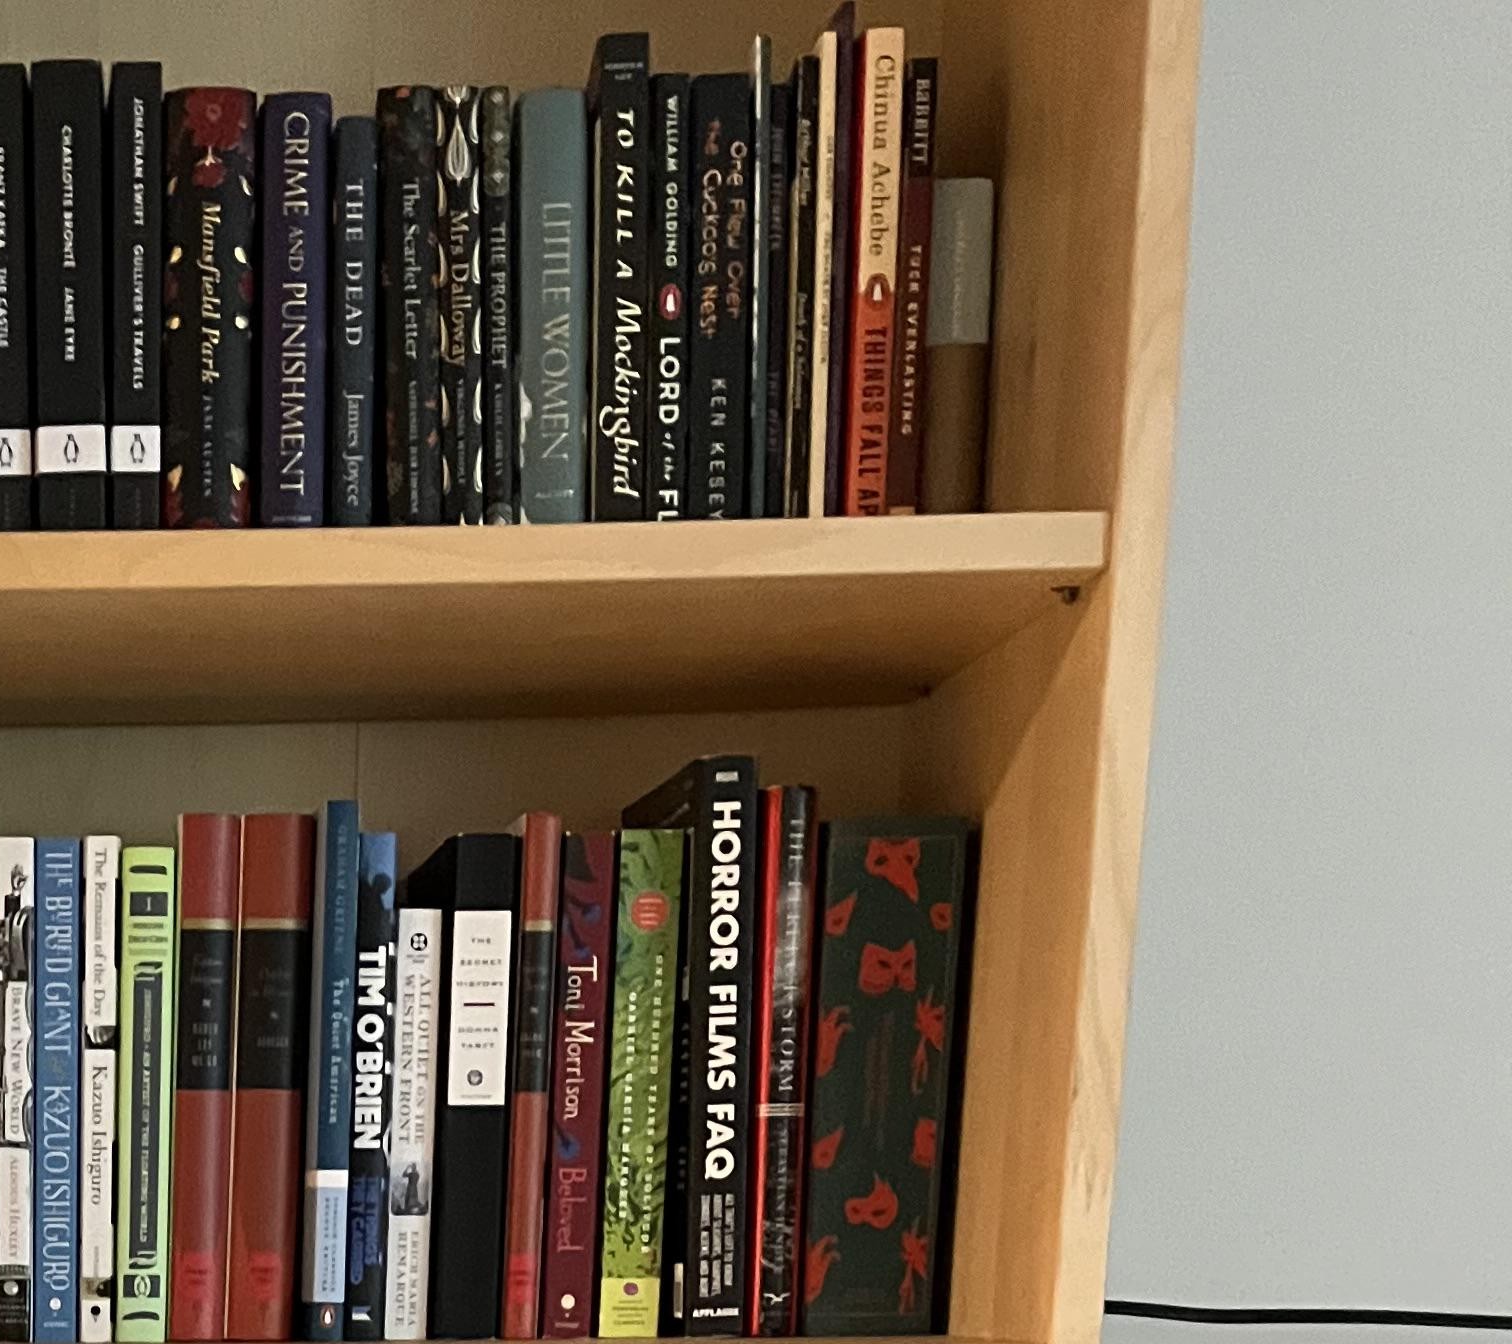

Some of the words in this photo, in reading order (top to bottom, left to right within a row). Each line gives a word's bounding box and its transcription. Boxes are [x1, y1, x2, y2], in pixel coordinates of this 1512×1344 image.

[282, 112, 310, 217] CRIME
[616, 108, 634, 147] TO
[665, 96, 678, 172] WILLIAM
[345, 179, 363, 242] THE
[401, 178, 420, 218] The
[616, 164, 634, 244] KILL
[665, 182, 678, 267] GOLDING
[197, 200, 221, 319] Mansfield
[287, 226, 304, 271] AND
[403, 223, 421, 293] Scarlet
[541, 200, 571, 302] LITTLE
[616, 259, 633, 279] A
[345, 261, 363, 347] DEAD
[403, 299, 421, 360] Letter
[201, 327, 220, 384] Park
[279, 282, 307, 496] PUNISHMENT
[539, 313, 570, 462] WOMEN
[658, 337, 681, 425] LORD
[344, 389, 364, 447] James
[599, 297, 641, 498] Mockingbird
[343, 450, 364, 507] Joyce
[662, 433, 676, 450] of
[662, 456, 676, 480] the
[709, 800, 742, 972] HORROR
[356, 946, 387, 1005] TIM
[564, 955, 598, 1010] Toni
[562, 1020, 595, 1121] Morrison
[707, 984, 738, 1090] FILMS
[89, 1065, 108, 1125] Kazuo
[353, 1014, 387, 1149] O'BRIEN
[87, 1130, 107, 1205] Ishiguro
[704, 1103, 735, 1179] FAQ
[555, 1166, 587, 1252] Beloved
